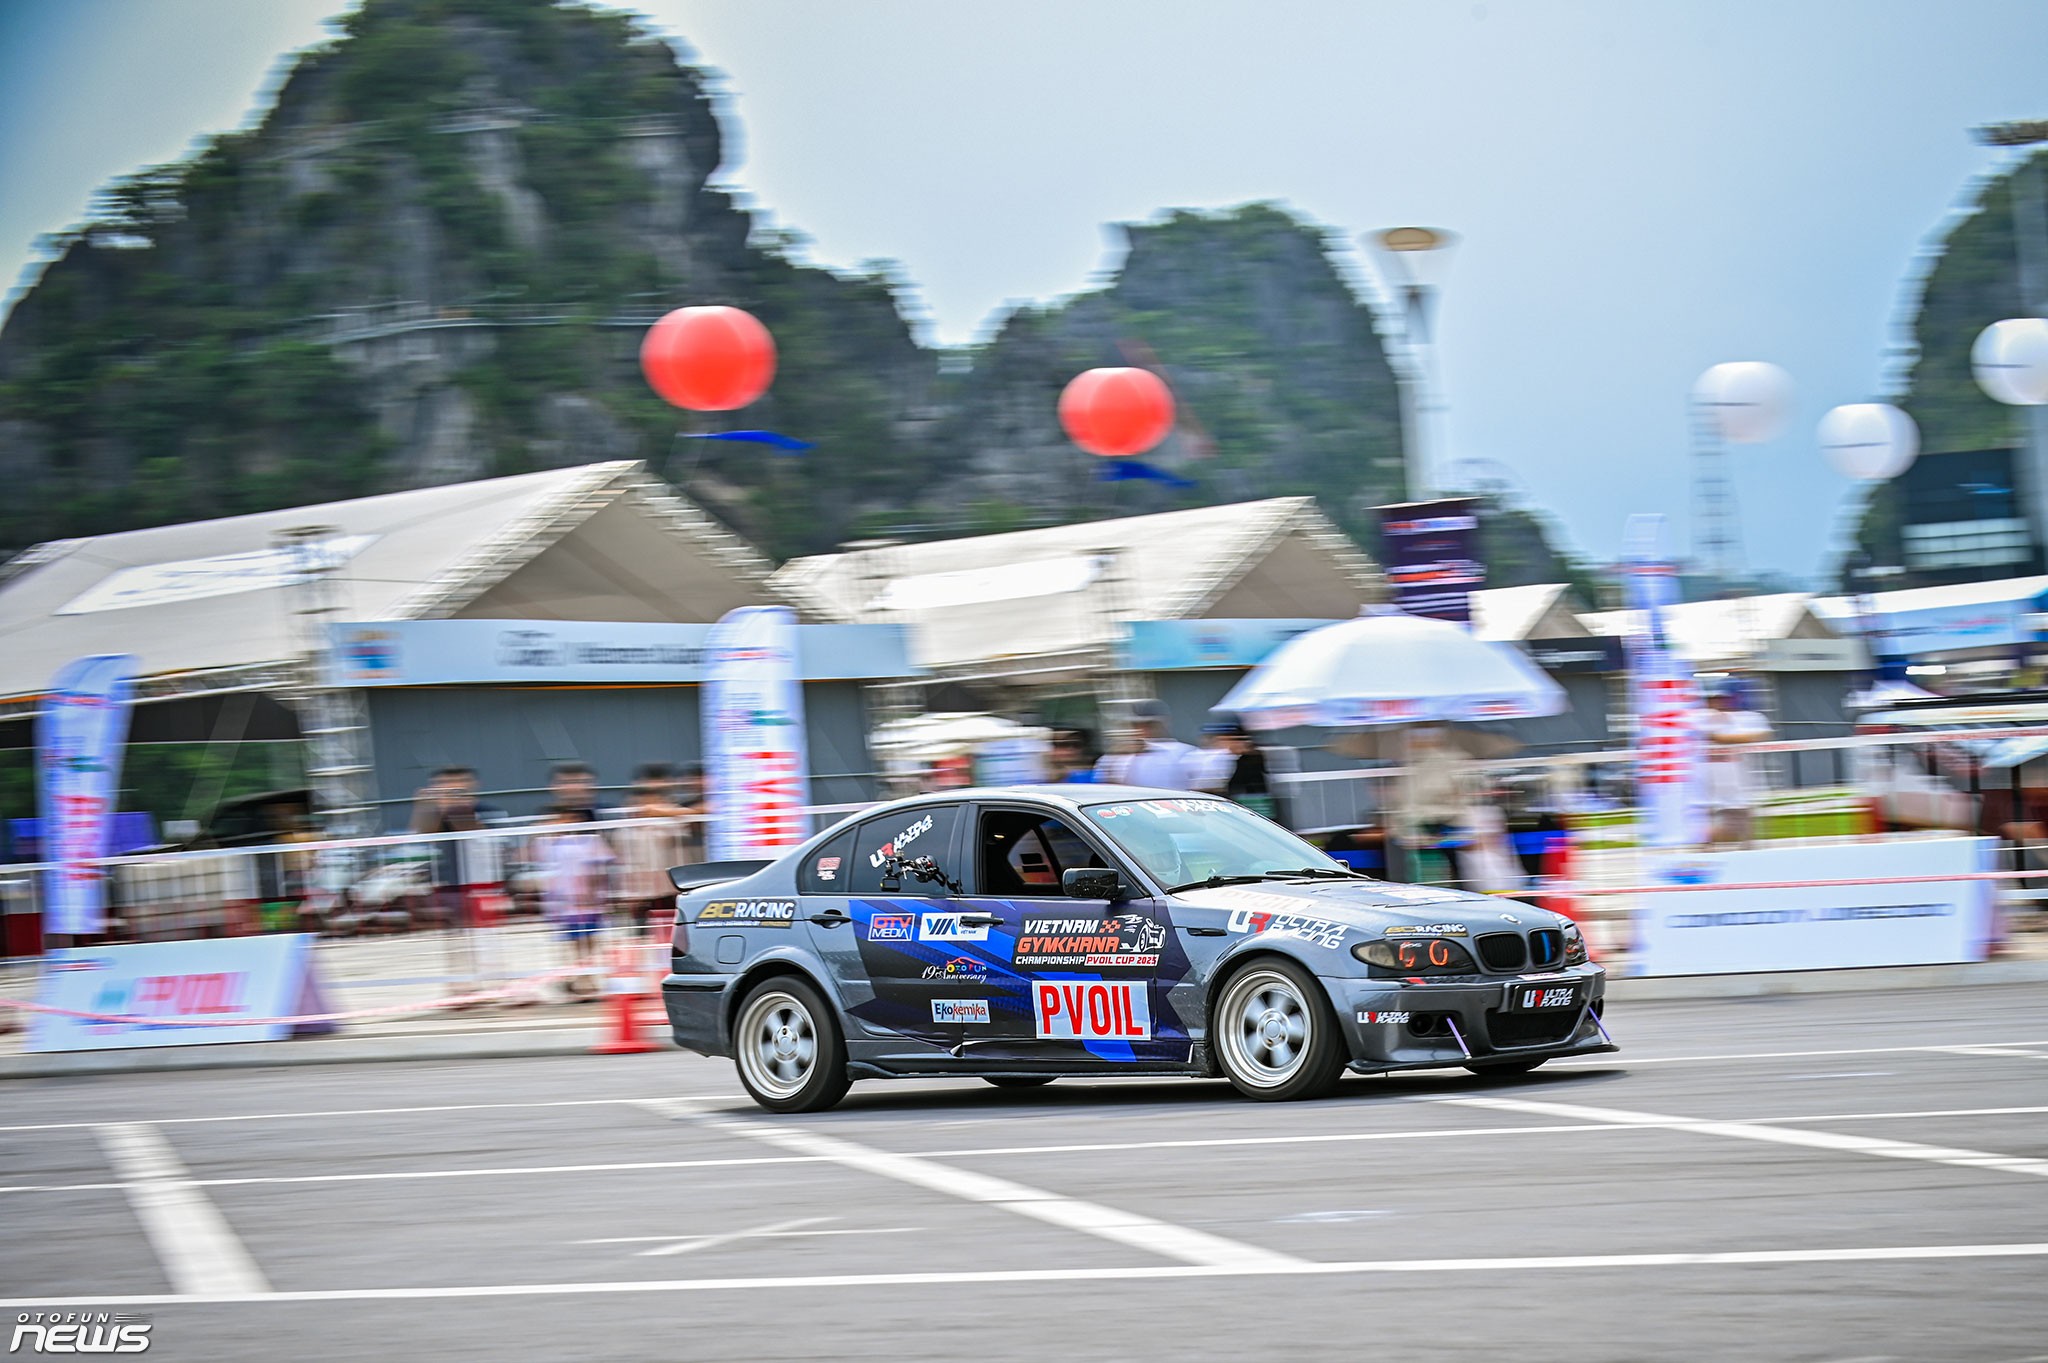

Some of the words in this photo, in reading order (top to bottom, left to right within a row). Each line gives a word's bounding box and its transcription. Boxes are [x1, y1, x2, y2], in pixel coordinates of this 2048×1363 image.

[734, 902, 794, 918] RACING
[872, 928, 908, 938] MEDIA
[1024, 919, 1099, 934] VIETNAM
[1414, 923, 1466, 933] RACING
[1017, 936, 1120, 953] GYMKHANA
[1015, 954, 1085, 965] CHAMPIONSHIP
[1086, 956, 1113, 965] PVOIL
[1115, 956, 1134, 965] CUP
[1136, 956, 1157, 965] 2025
[1543, 988, 1574, 998] ULTRA
[934, 1002, 986, 1020] Ekokemika
[1039, 985, 1143, 1036] PVOIL
